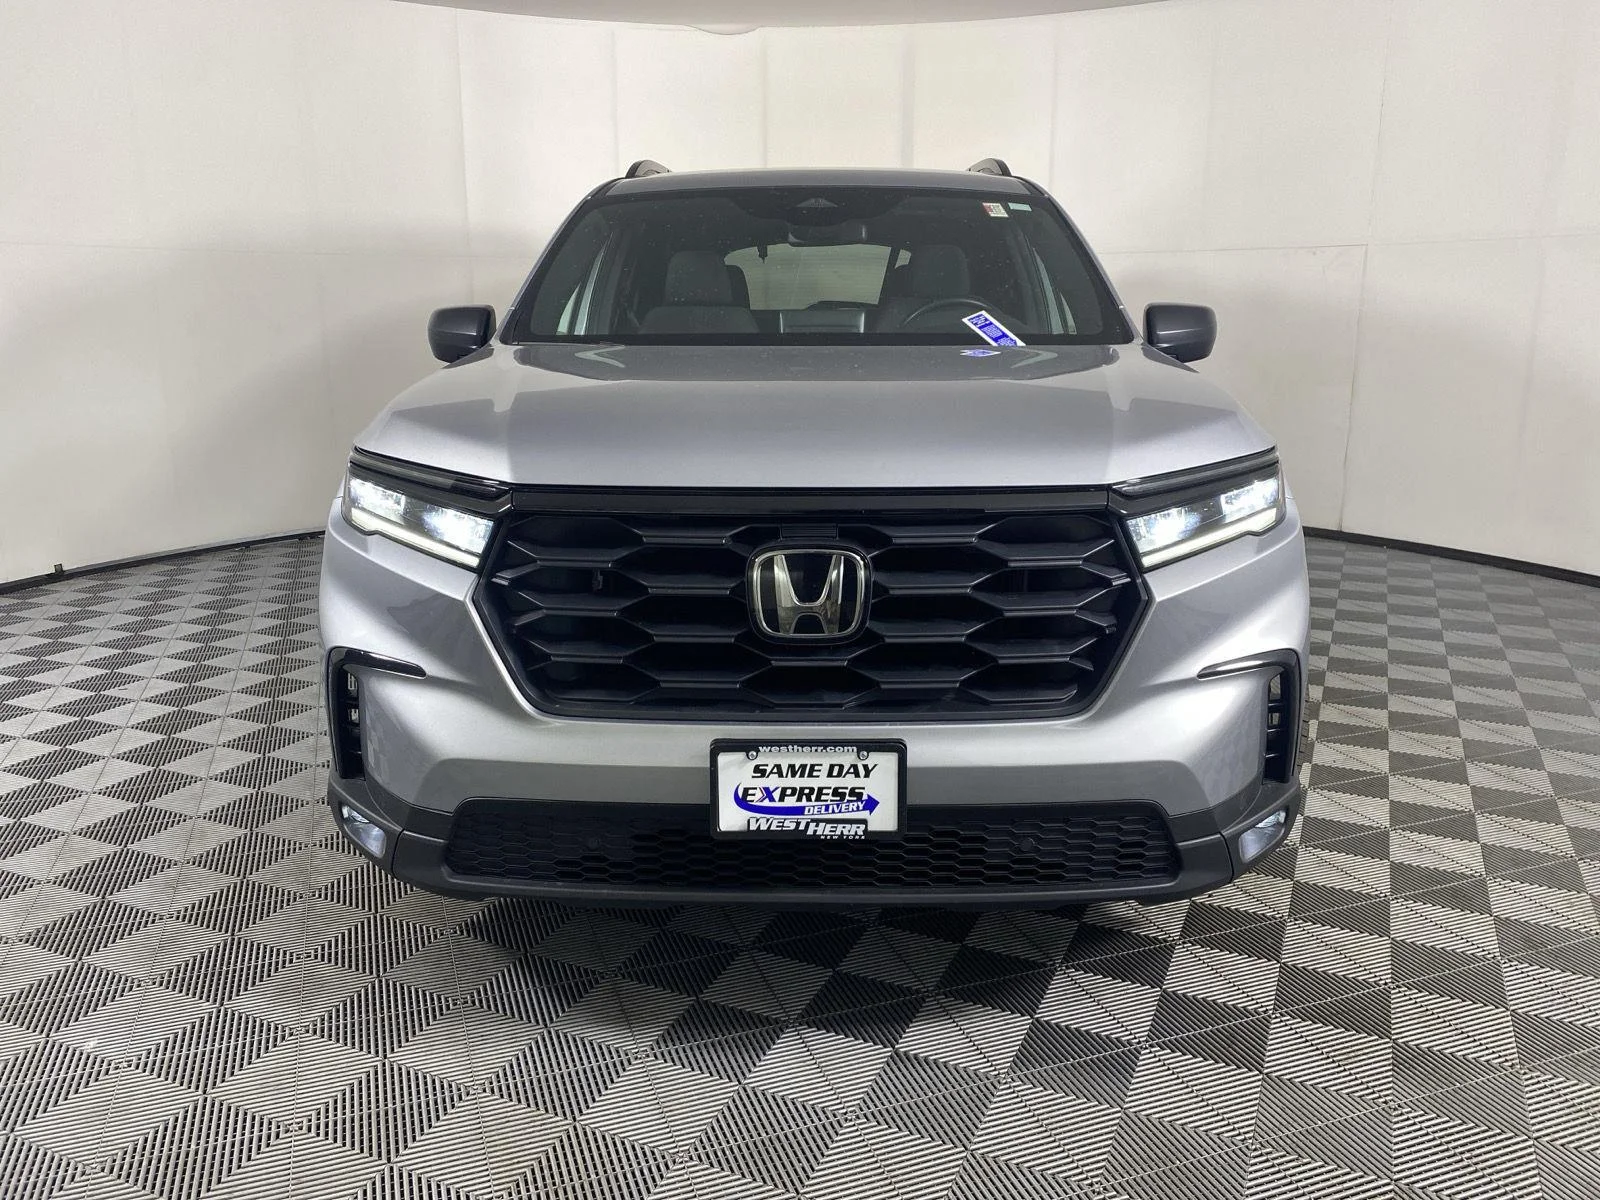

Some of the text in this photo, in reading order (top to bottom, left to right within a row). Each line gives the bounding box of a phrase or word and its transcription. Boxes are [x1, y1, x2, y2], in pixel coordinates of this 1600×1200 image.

[758, 745, 858, 753] westherr.com
[751, 763, 878, 779] SAME DAY
[741, 786, 866, 803] EXPRESS
[804, 801, 866, 815] DELIVERY
[749, 817, 866, 836] WEST HERR
